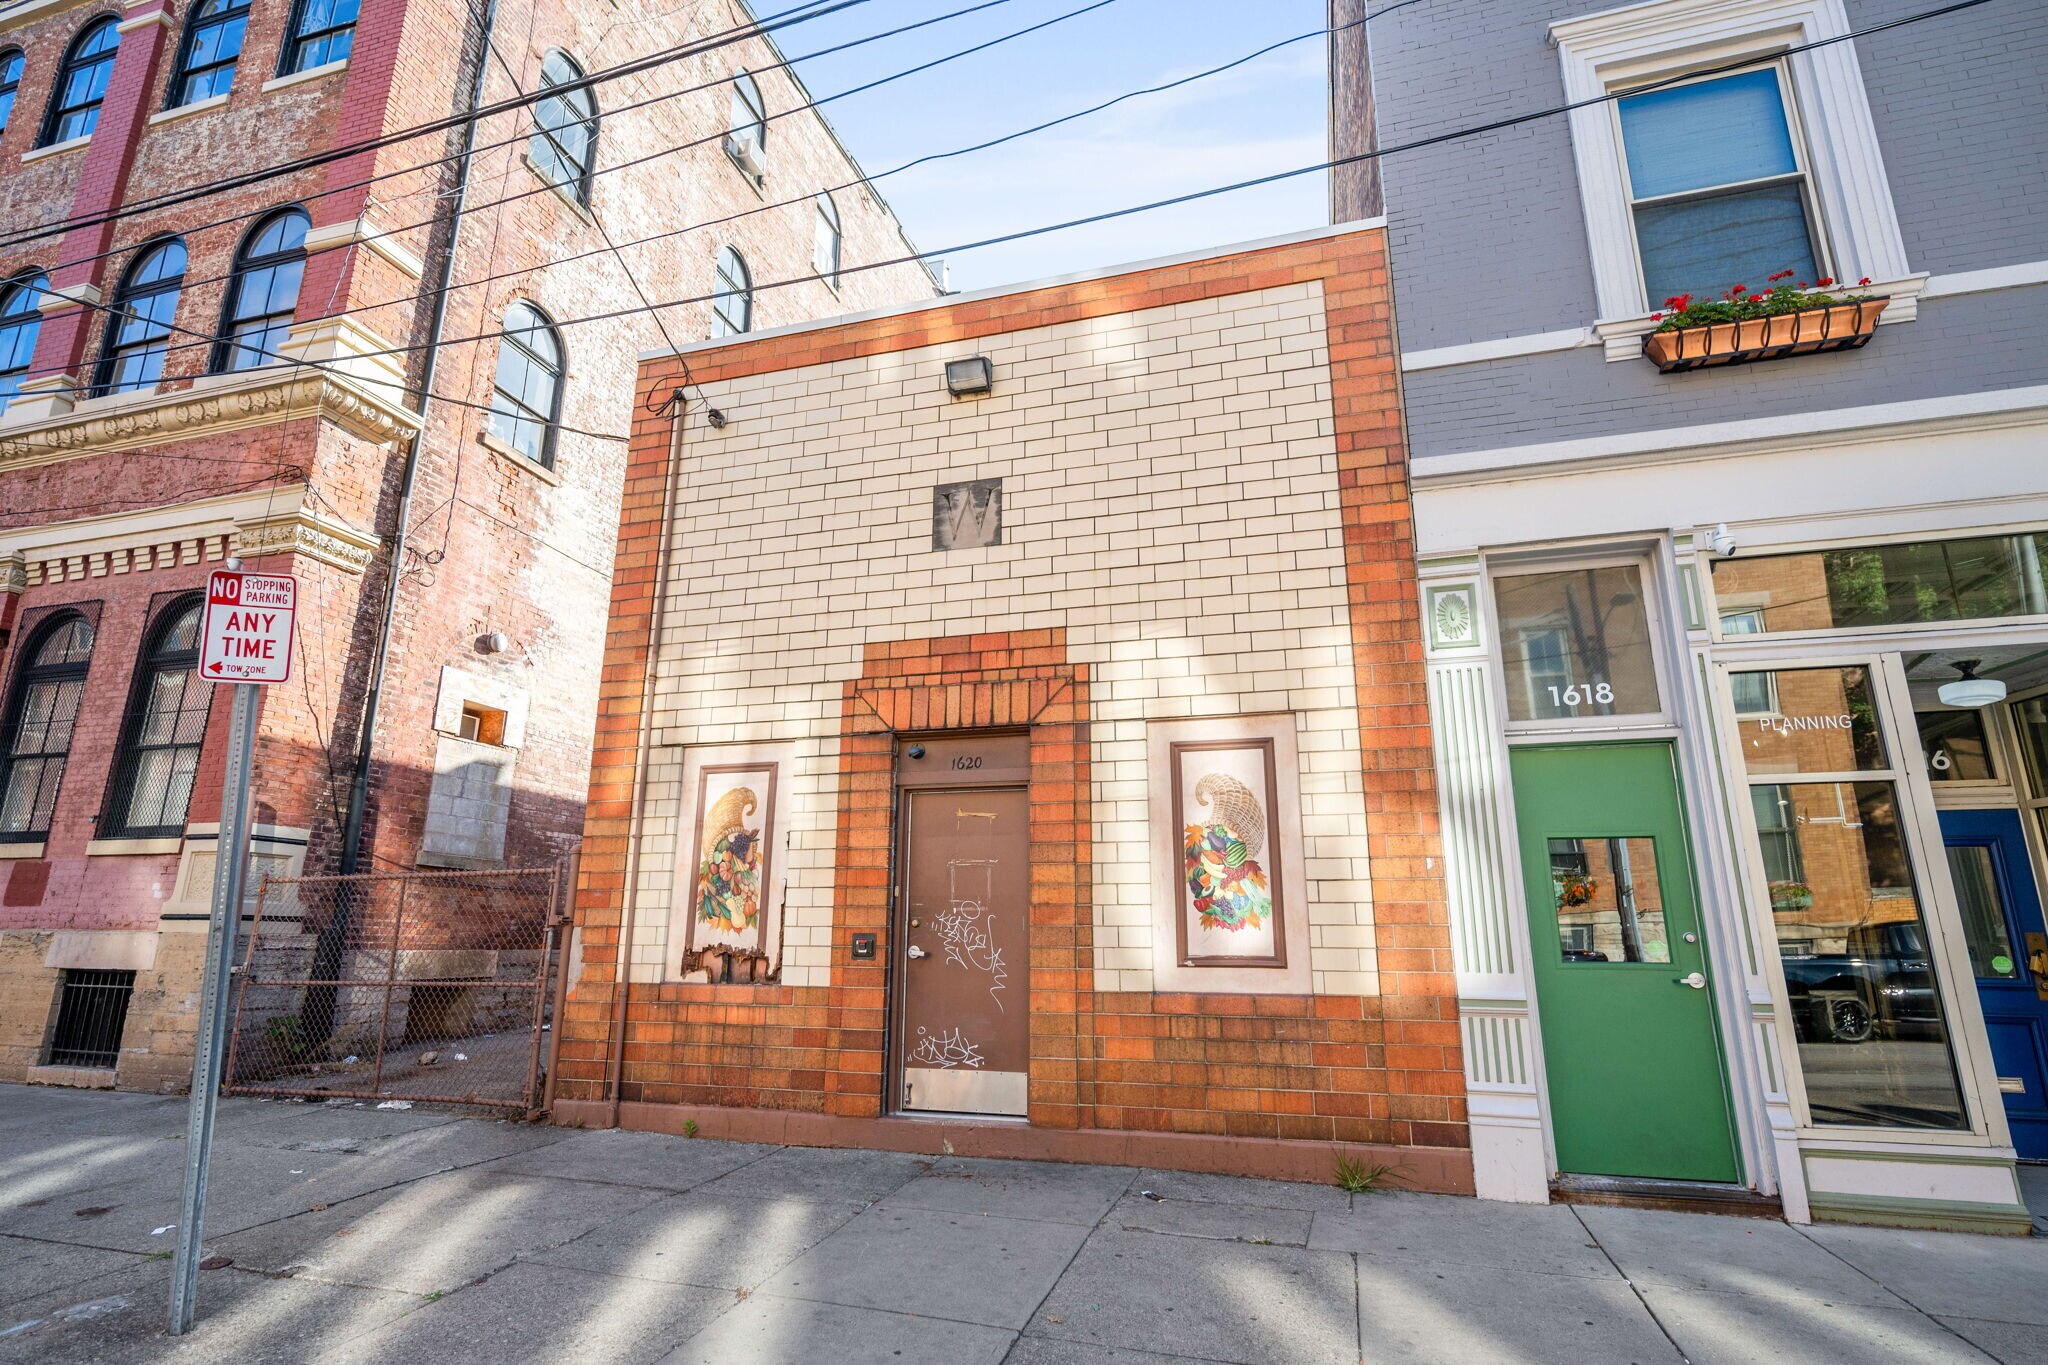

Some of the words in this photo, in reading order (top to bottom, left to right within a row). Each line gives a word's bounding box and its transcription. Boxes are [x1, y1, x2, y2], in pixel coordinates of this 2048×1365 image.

[211, 576, 239, 599] NO
[244, 579, 291, 593] STOPPING
[246, 591, 288, 605] PARKING
[225, 611, 277, 634] ANY
[222, 636, 277, 660] TIME
[226, 664, 243, 673] TOW
[245, 665, 267, 674] ZONE
[1547, 682, 1615, 707] 1618
[1759, 714, 1853, 732] PLANNING
[951, 755, 983, 771] 1620
